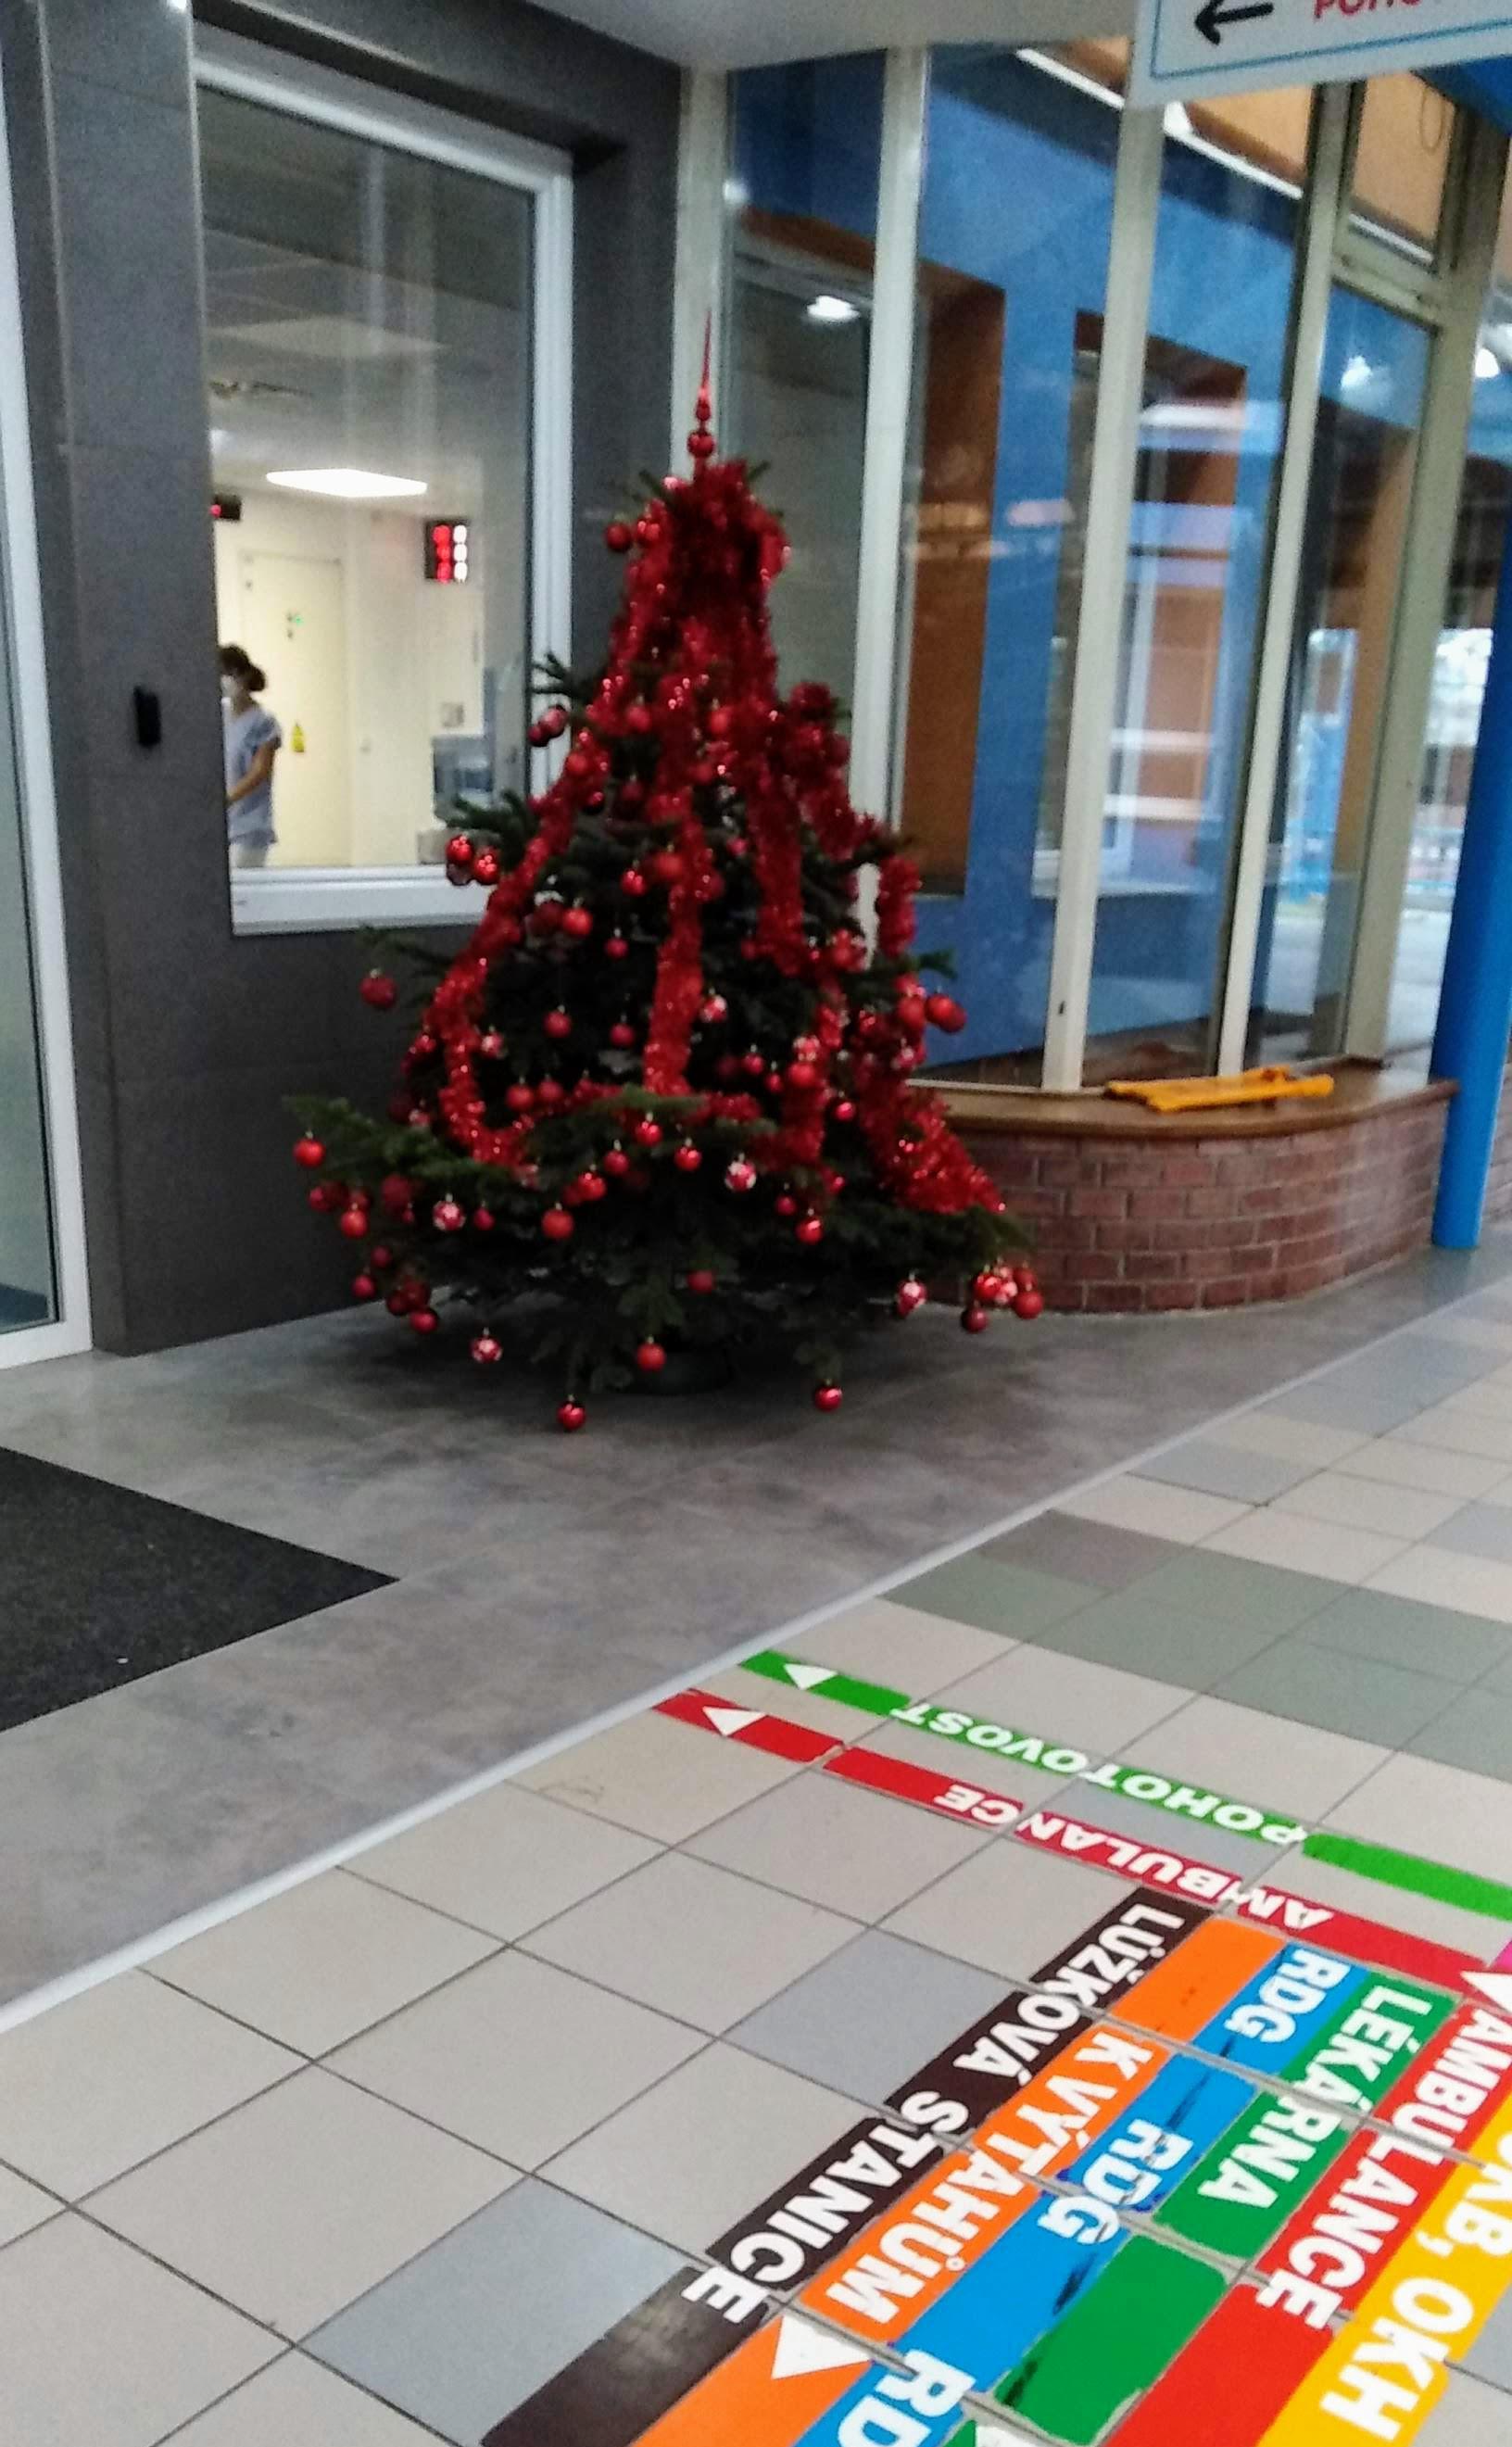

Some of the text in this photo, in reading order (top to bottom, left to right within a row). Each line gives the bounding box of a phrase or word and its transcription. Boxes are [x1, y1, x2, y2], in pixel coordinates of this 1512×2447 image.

[889, 1703, 1306, 1845] POHOTOVOST
[936, 1785, 1330, 1929] AMBULANCE
[1226, 1949, 1352, 2044] RDG
[826, 2032, 1153, 2324] K VÝTAHŮM
[1200, 1987, 1432, 2209] LÉKÁRNA
[1255, 2008, 1512, 2329] AMBULANCE
[681, 2091, 970, 2323] STANICE
[1039, 2122, 1193, 2244] RDG
[1319, 2277, 1473, 2441] OKH
